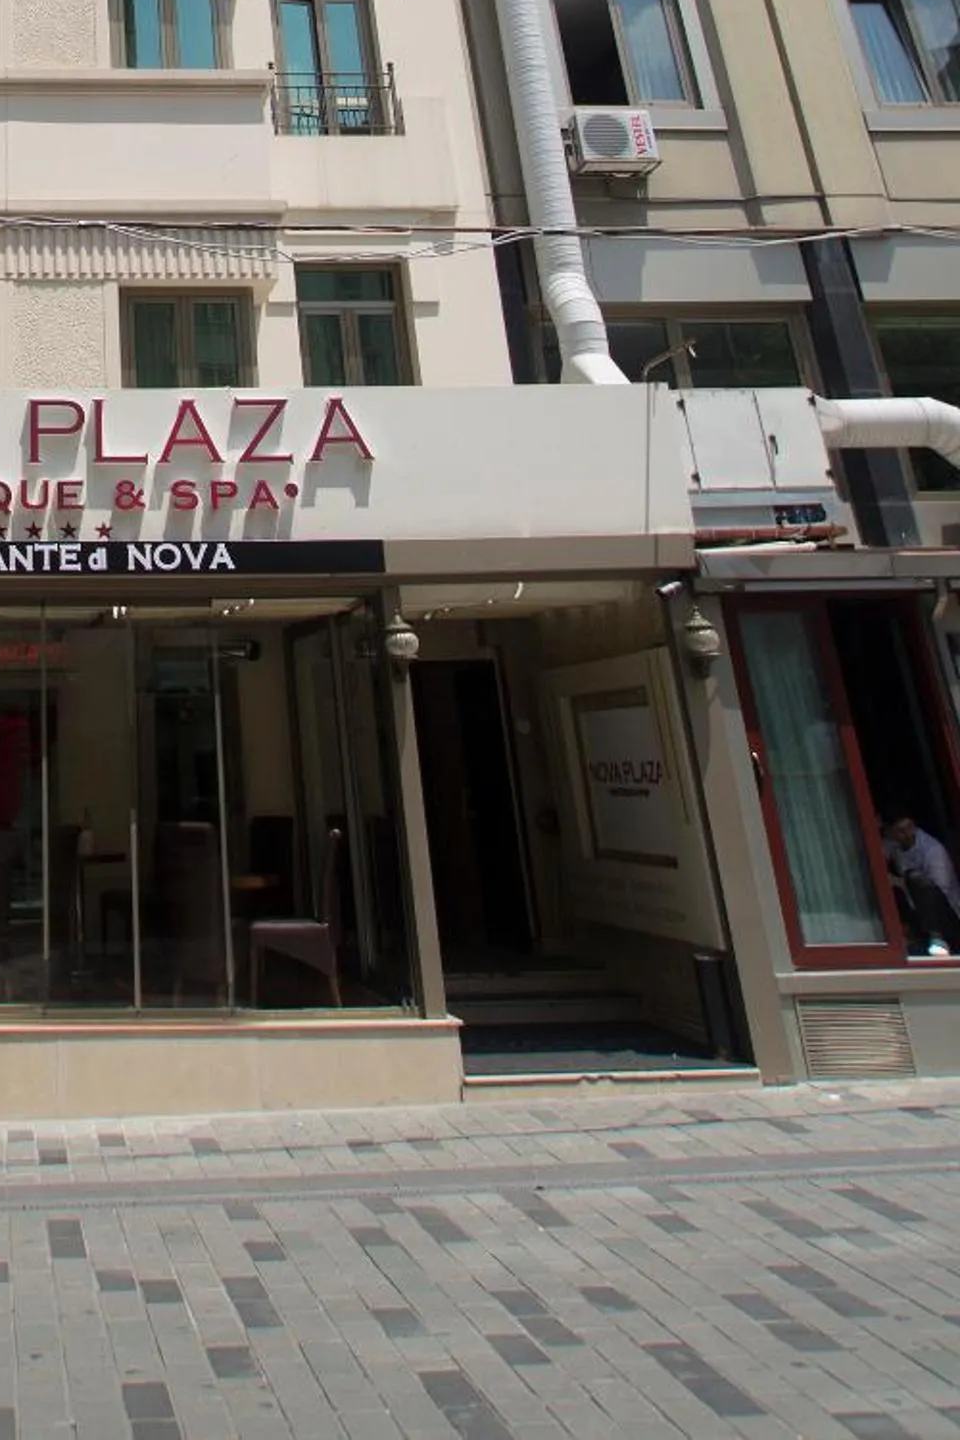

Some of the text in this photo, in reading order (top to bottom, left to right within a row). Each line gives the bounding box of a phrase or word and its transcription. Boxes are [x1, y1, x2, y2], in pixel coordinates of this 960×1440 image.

[28, 398, 375, 463] PLAZA
[113, 479, 146, 510] &
[170, 479, 281, 511] SPA
[126, 543, 236, 572] NOVA
